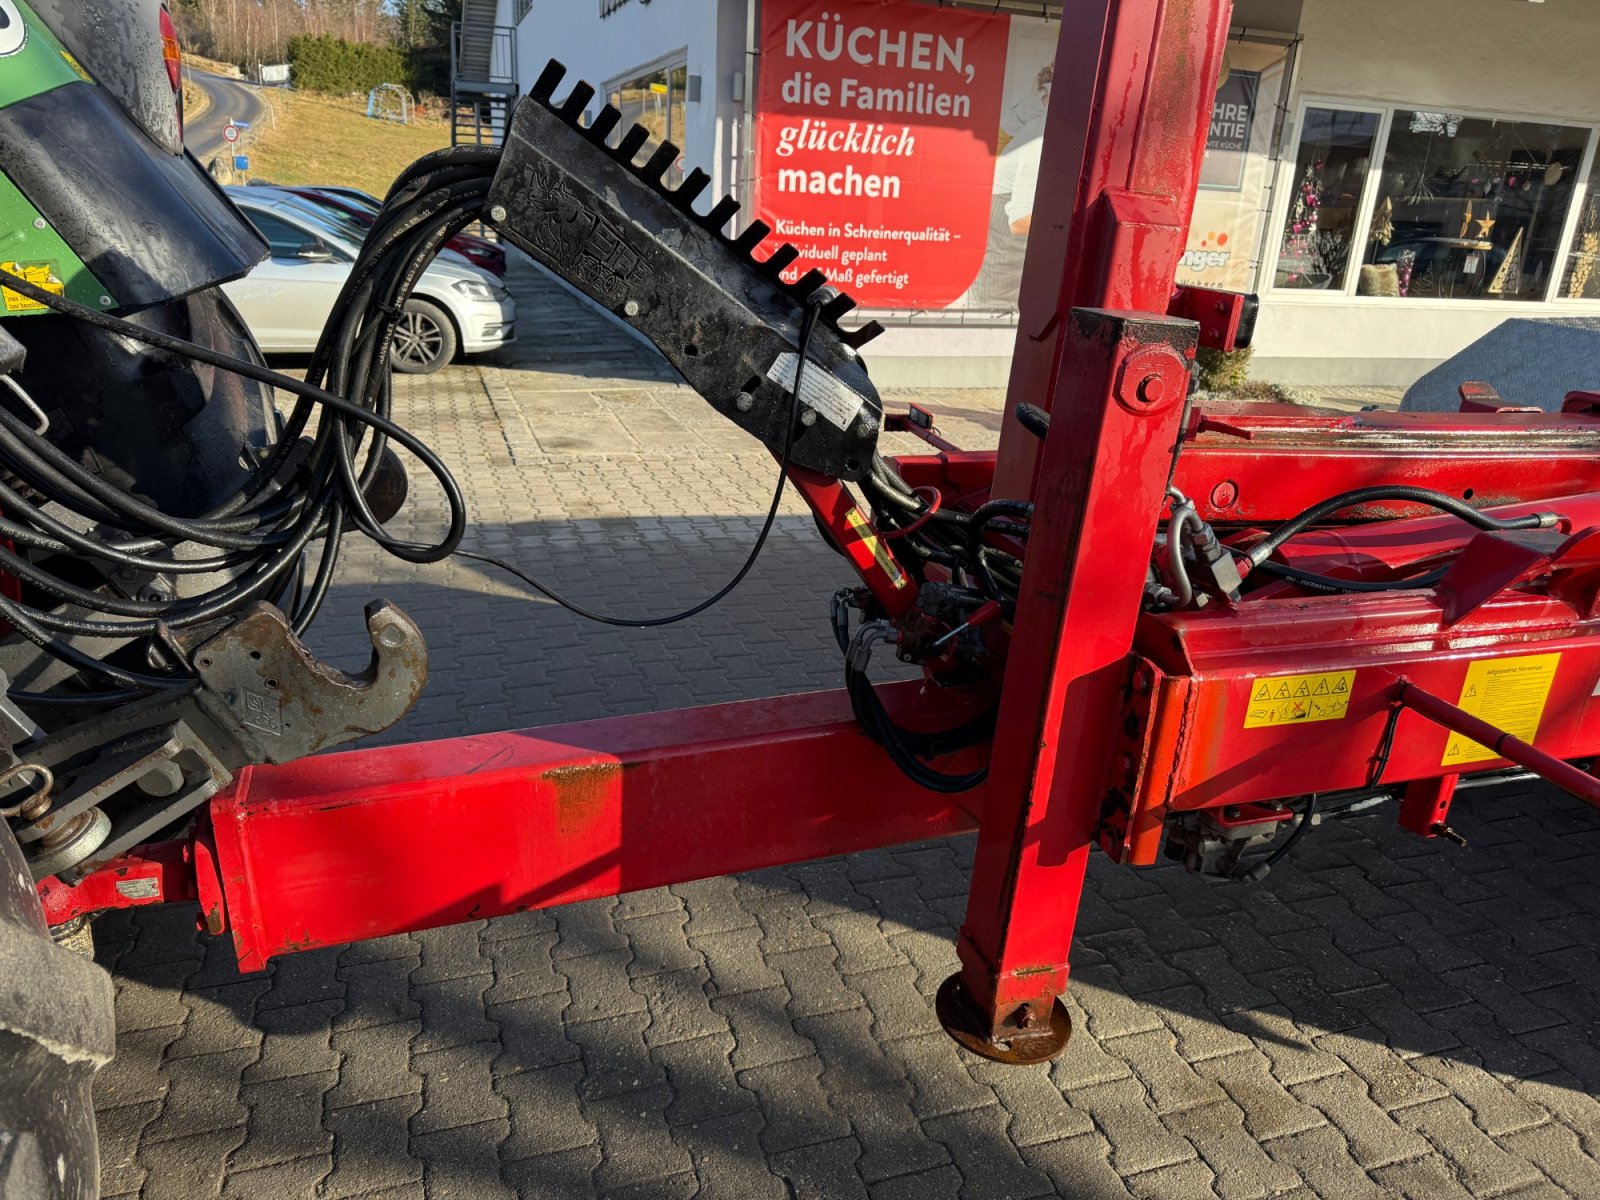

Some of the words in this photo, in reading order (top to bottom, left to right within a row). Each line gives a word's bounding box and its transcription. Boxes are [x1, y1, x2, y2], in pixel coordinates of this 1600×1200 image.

[785, 12, 975, 84] KÜCHEN,
[781, 72, 831, 105] die
[840, 78, 970, 117] Familien
[775, 119, 915, 157] glücklich
[777, 165, 901, 199] machen
[775, 219, 825, 237] Küchen
[828, 222, 840, 237] in
[844, 222, 950, 246] Schreinerqualität
[841, 247, 888, 266] geplant
[778, 266, 798, 281] nd
[825, 267, 853, 283] Maß
[855, 269, 909, 290] gefertigt
